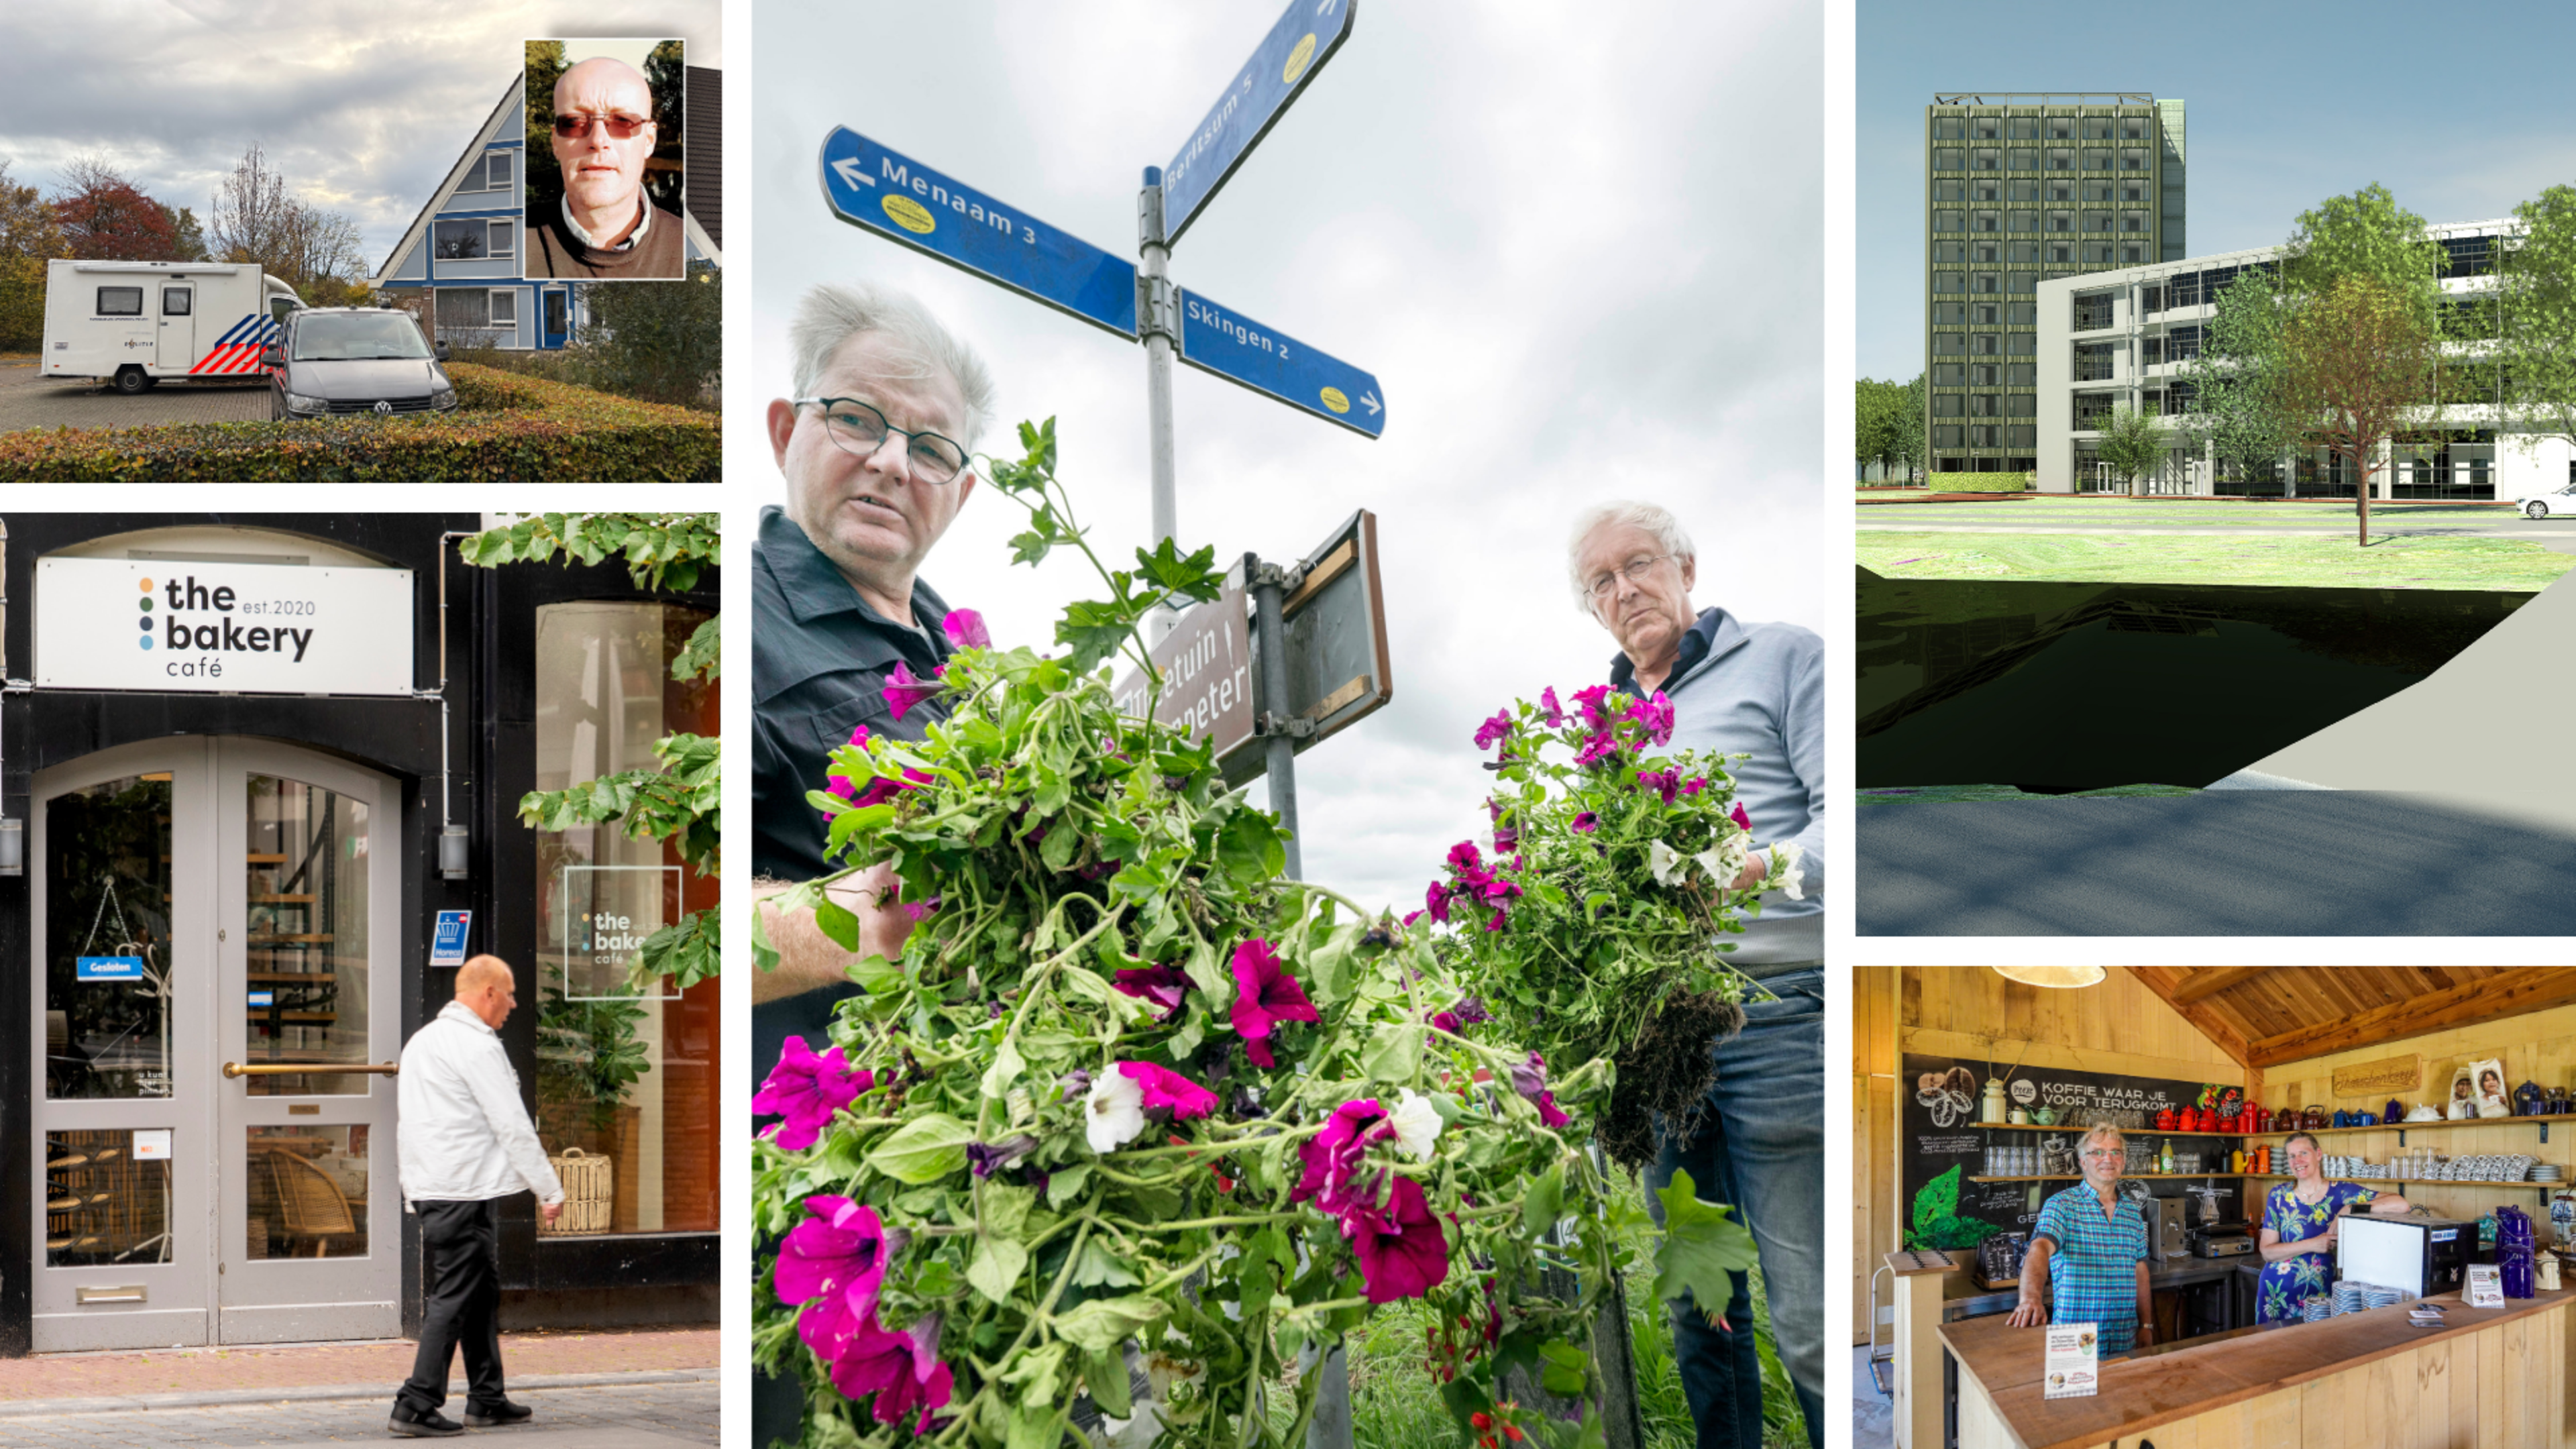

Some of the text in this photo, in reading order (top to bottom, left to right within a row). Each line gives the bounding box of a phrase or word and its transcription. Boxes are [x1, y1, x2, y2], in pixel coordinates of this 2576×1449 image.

[1167, 73, 1252, 192] Berltsum 5
[881, 156, 1012, 235] Menaam
[1023, 226, 1036, 245] 3
[1188, 301, 1289, 360] Skingen 2
[165, 576, 316, 615] the est.2020
[166, 615, 313, 663] bakery
[166, 657, 222, 678] café
[594, 911, 631, 930] the
[595, 931, 647, 951] bake
[435, 947, 462, 957] Horeca
[595, 952, 623, 964] café
[90, 962, 131, 972] Gesloten
[2041, 1082, 2166, 1102] KOFFIE WAAR JE
[2043, 1093, 2177, 1112] VOOR TERUGKOMT
